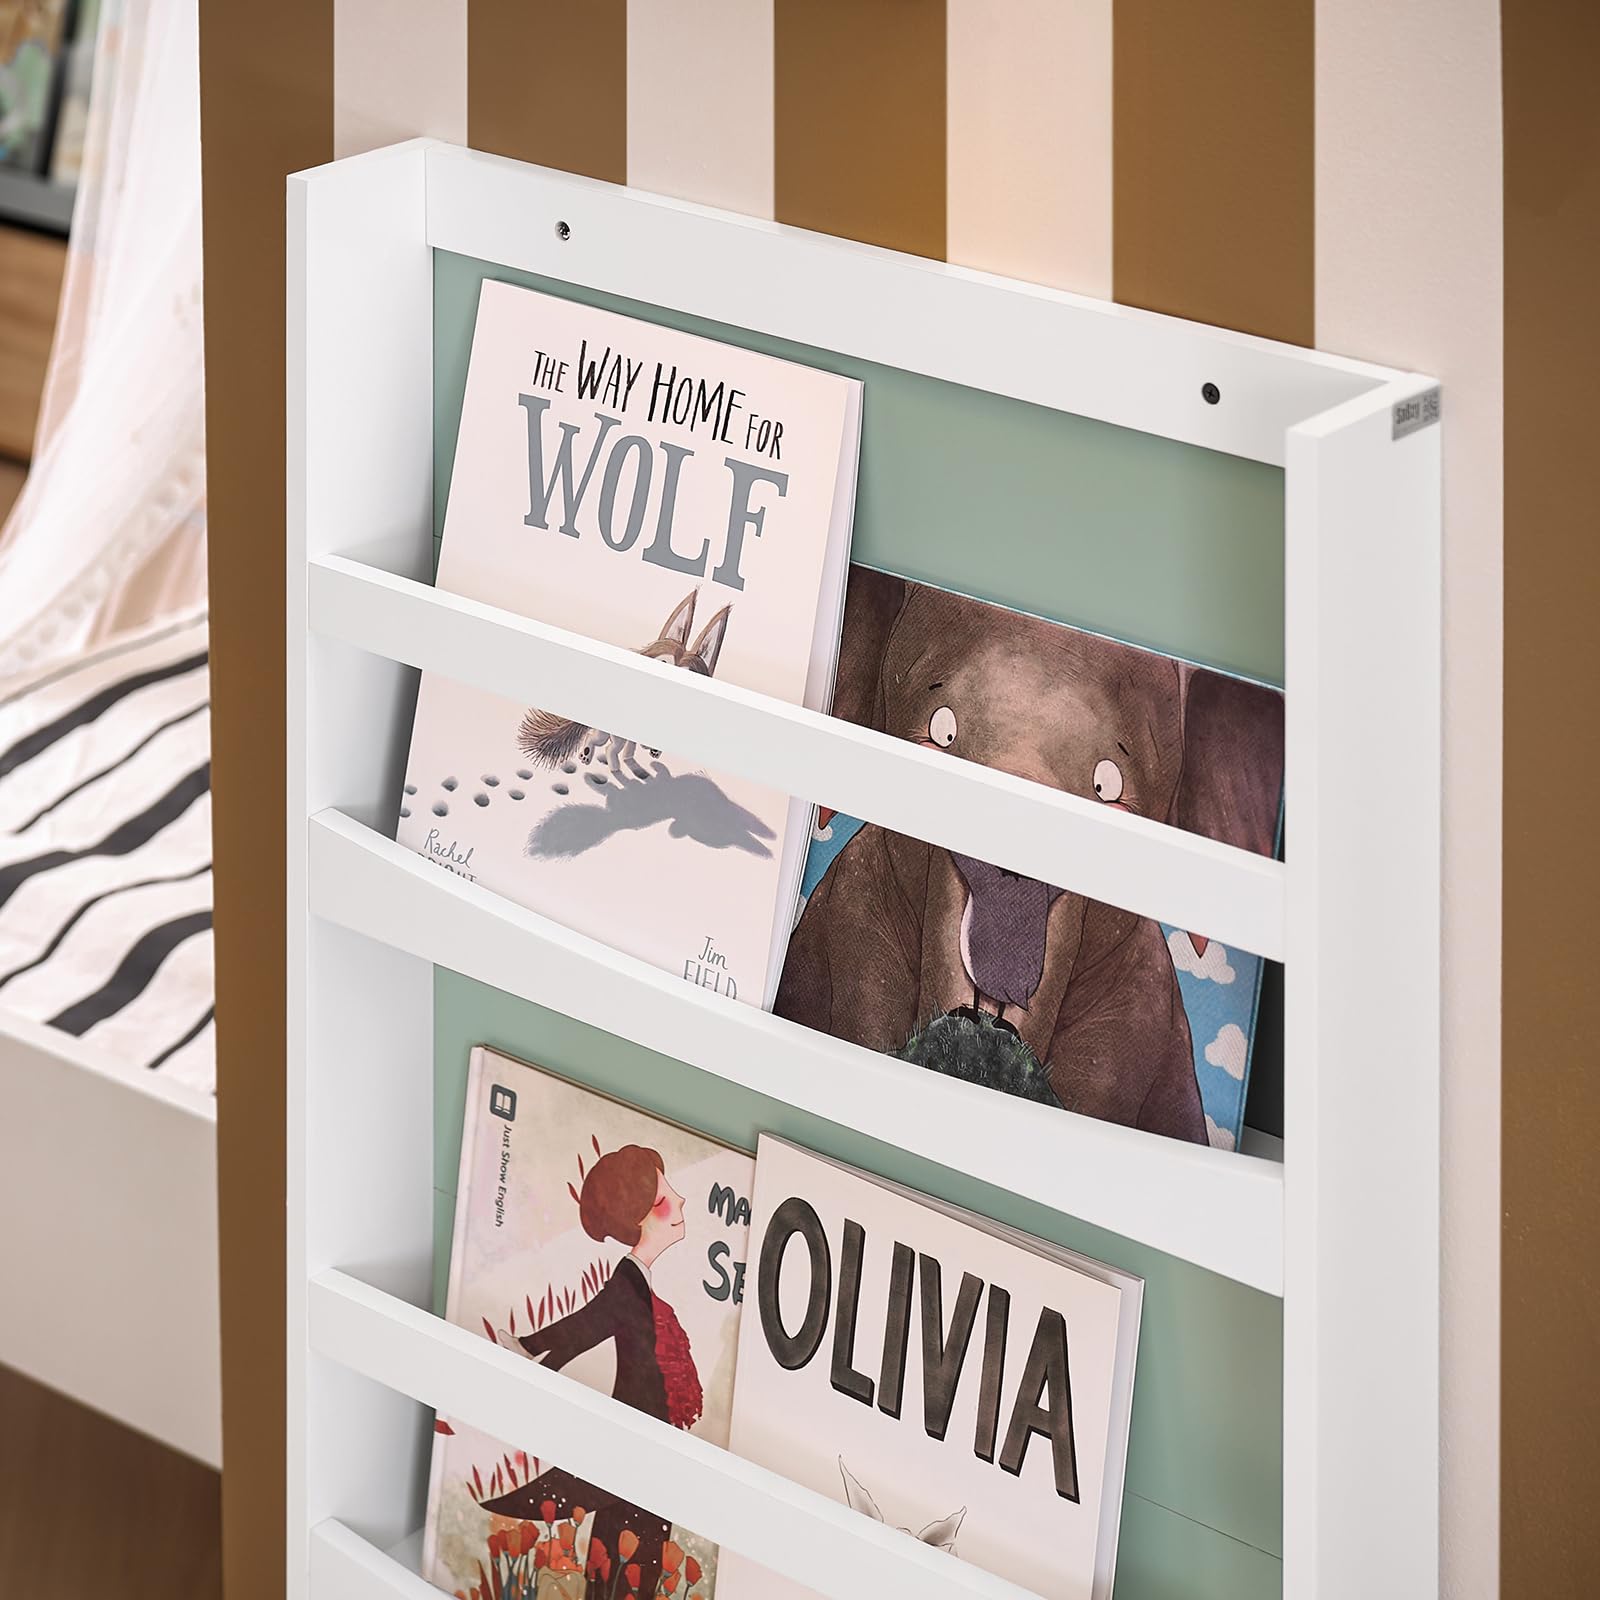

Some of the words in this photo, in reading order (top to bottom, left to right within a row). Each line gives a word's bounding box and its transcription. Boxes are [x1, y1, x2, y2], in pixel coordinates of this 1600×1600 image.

[533, 350, 570, 393] THE
[577, 339, 643, 413] WAY
[647, 362, 746, 445] HOME
[745, 413, 784, 460] FOR
[518, 392, 789, 592] WOLF
[423, 828, 474, 869] Rachel
[698, 935, 728, 970] Jim
[502, 1124, 513, 1148] Just
[499, 1150, 511, 1184] Show
[494, 1185, 508, 1228] English
[708, 1181, 752, 1227] MA
[758, 1196, 1081, 1505] OLIVIA
